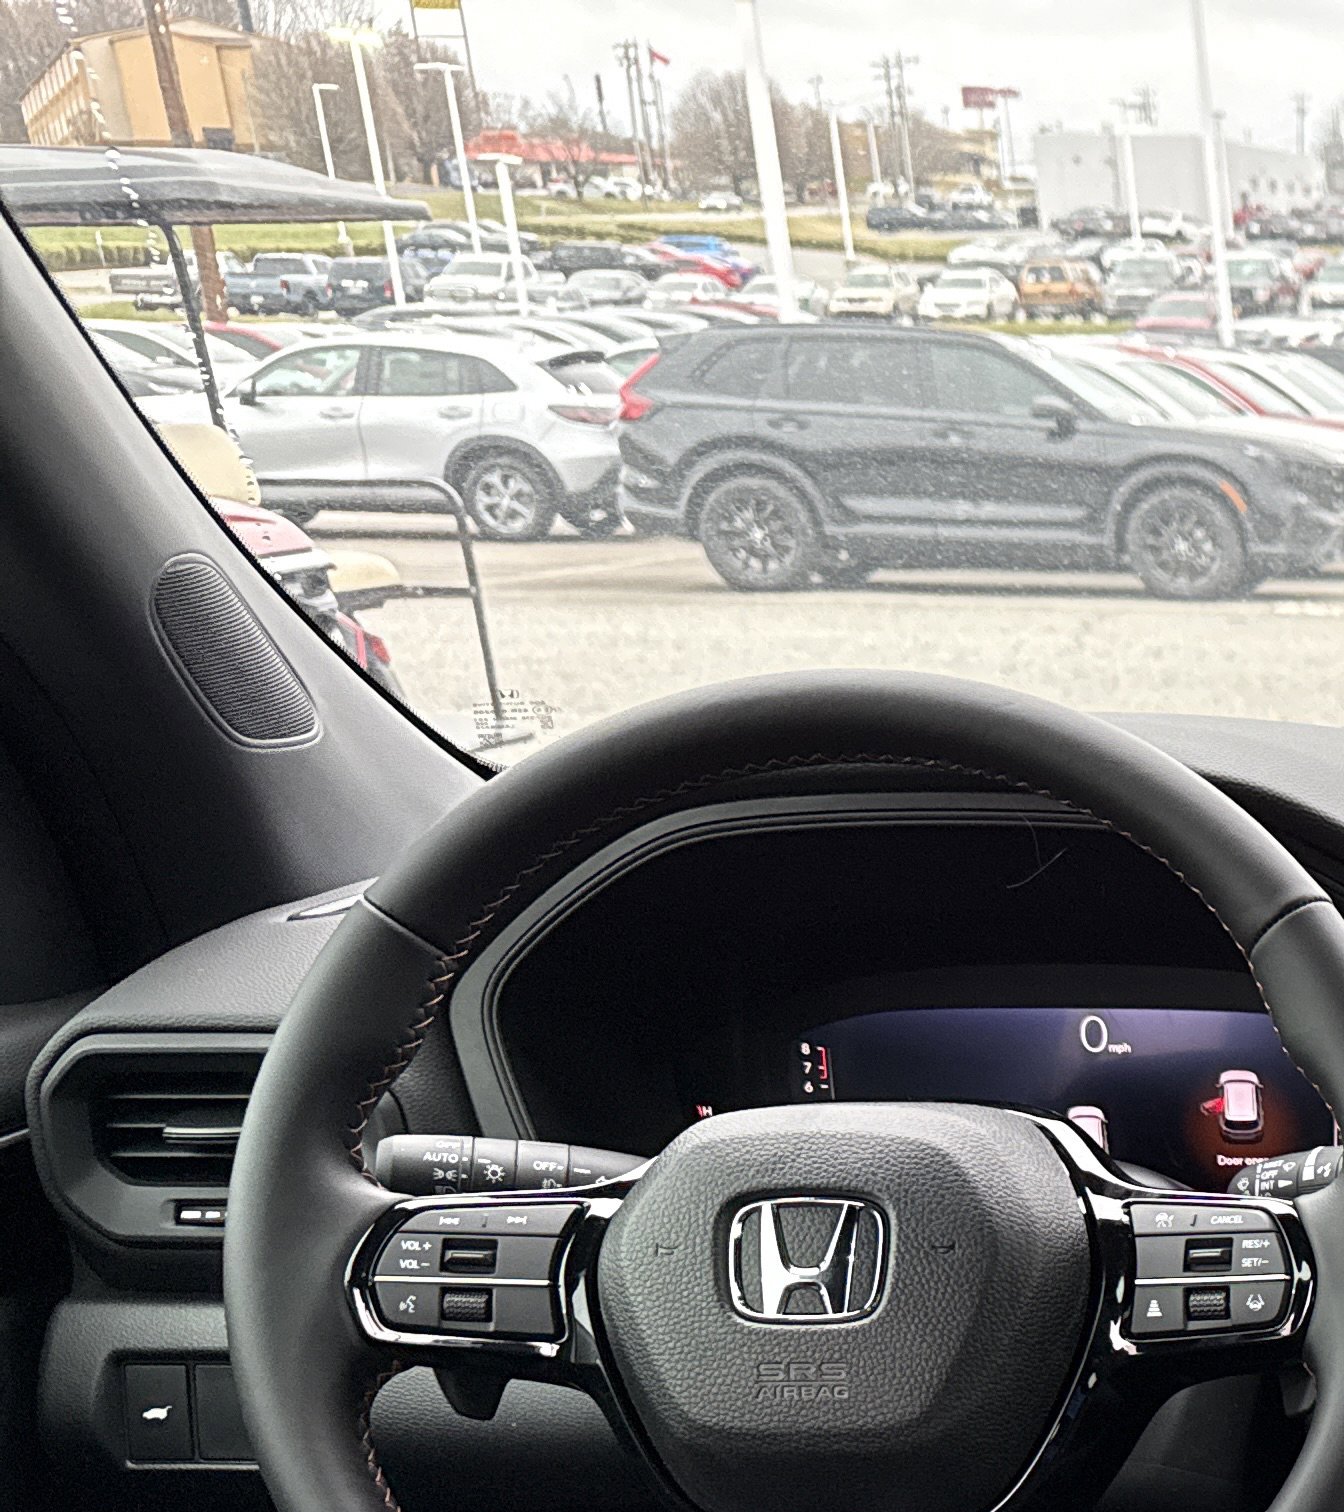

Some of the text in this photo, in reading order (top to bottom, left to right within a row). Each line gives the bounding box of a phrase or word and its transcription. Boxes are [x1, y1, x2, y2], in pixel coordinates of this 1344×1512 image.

[1079, 1014, 1132, 1055] 0 mph
[801, 1042, 811, 1055] 8
[803, 1061, 812, 1074] 7
[804, 1081, 814, 1093] 6
[422, 1151, 459, 1164] AUTO
[1216, 1154, 1243, 1166] Door
[533, 1160, 557, 1171] OFF
[1261, 1170, 1278, 1180] OFF
[1261, 1180, 1275, 1191] INT
[1210, 1215, 1244, 1225] CANCEL
[756, 1361, 848, 1381] SRS
[755, 1384, 849, 1400] AIRBAG
